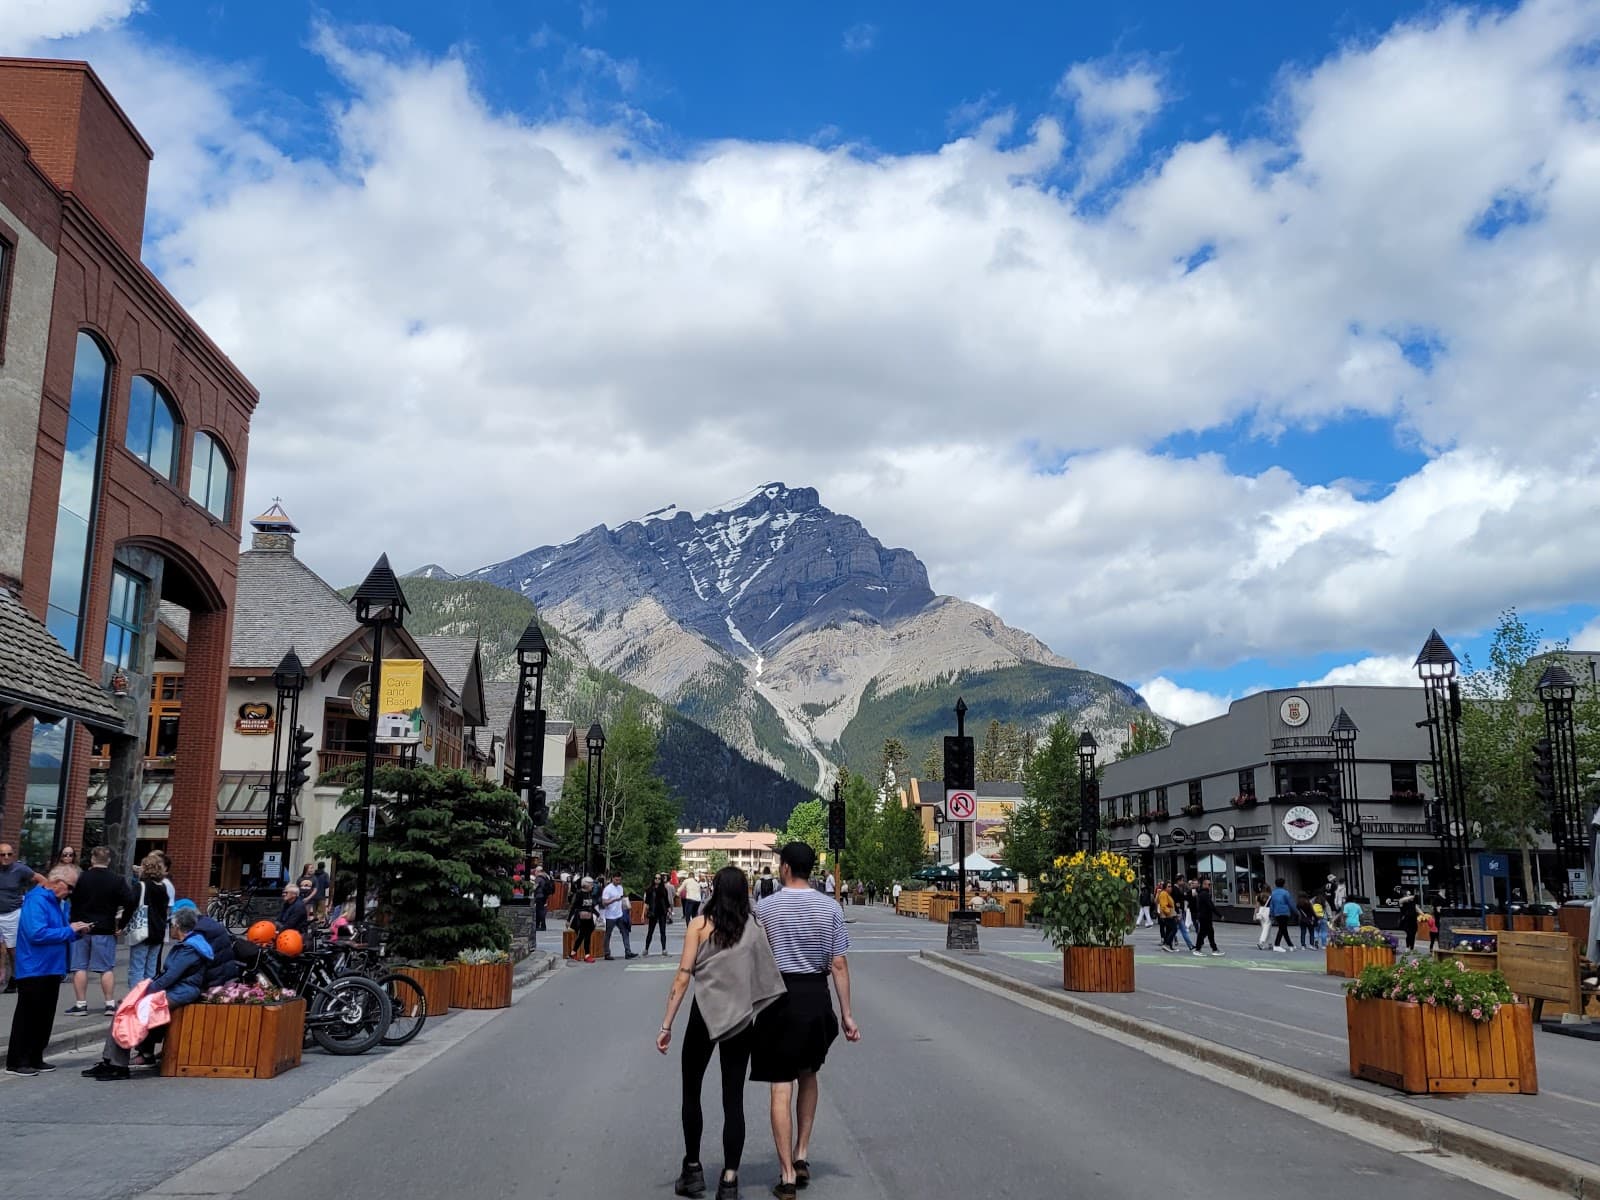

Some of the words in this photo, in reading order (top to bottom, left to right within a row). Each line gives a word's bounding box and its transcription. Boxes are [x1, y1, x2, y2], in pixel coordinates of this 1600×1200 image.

[387, 677, 411, 687] Cave
[387, 688, 404, 696] and
[386, 696, 413, 705] Basin
[215, 828, 267, 836] TARBUCKS
